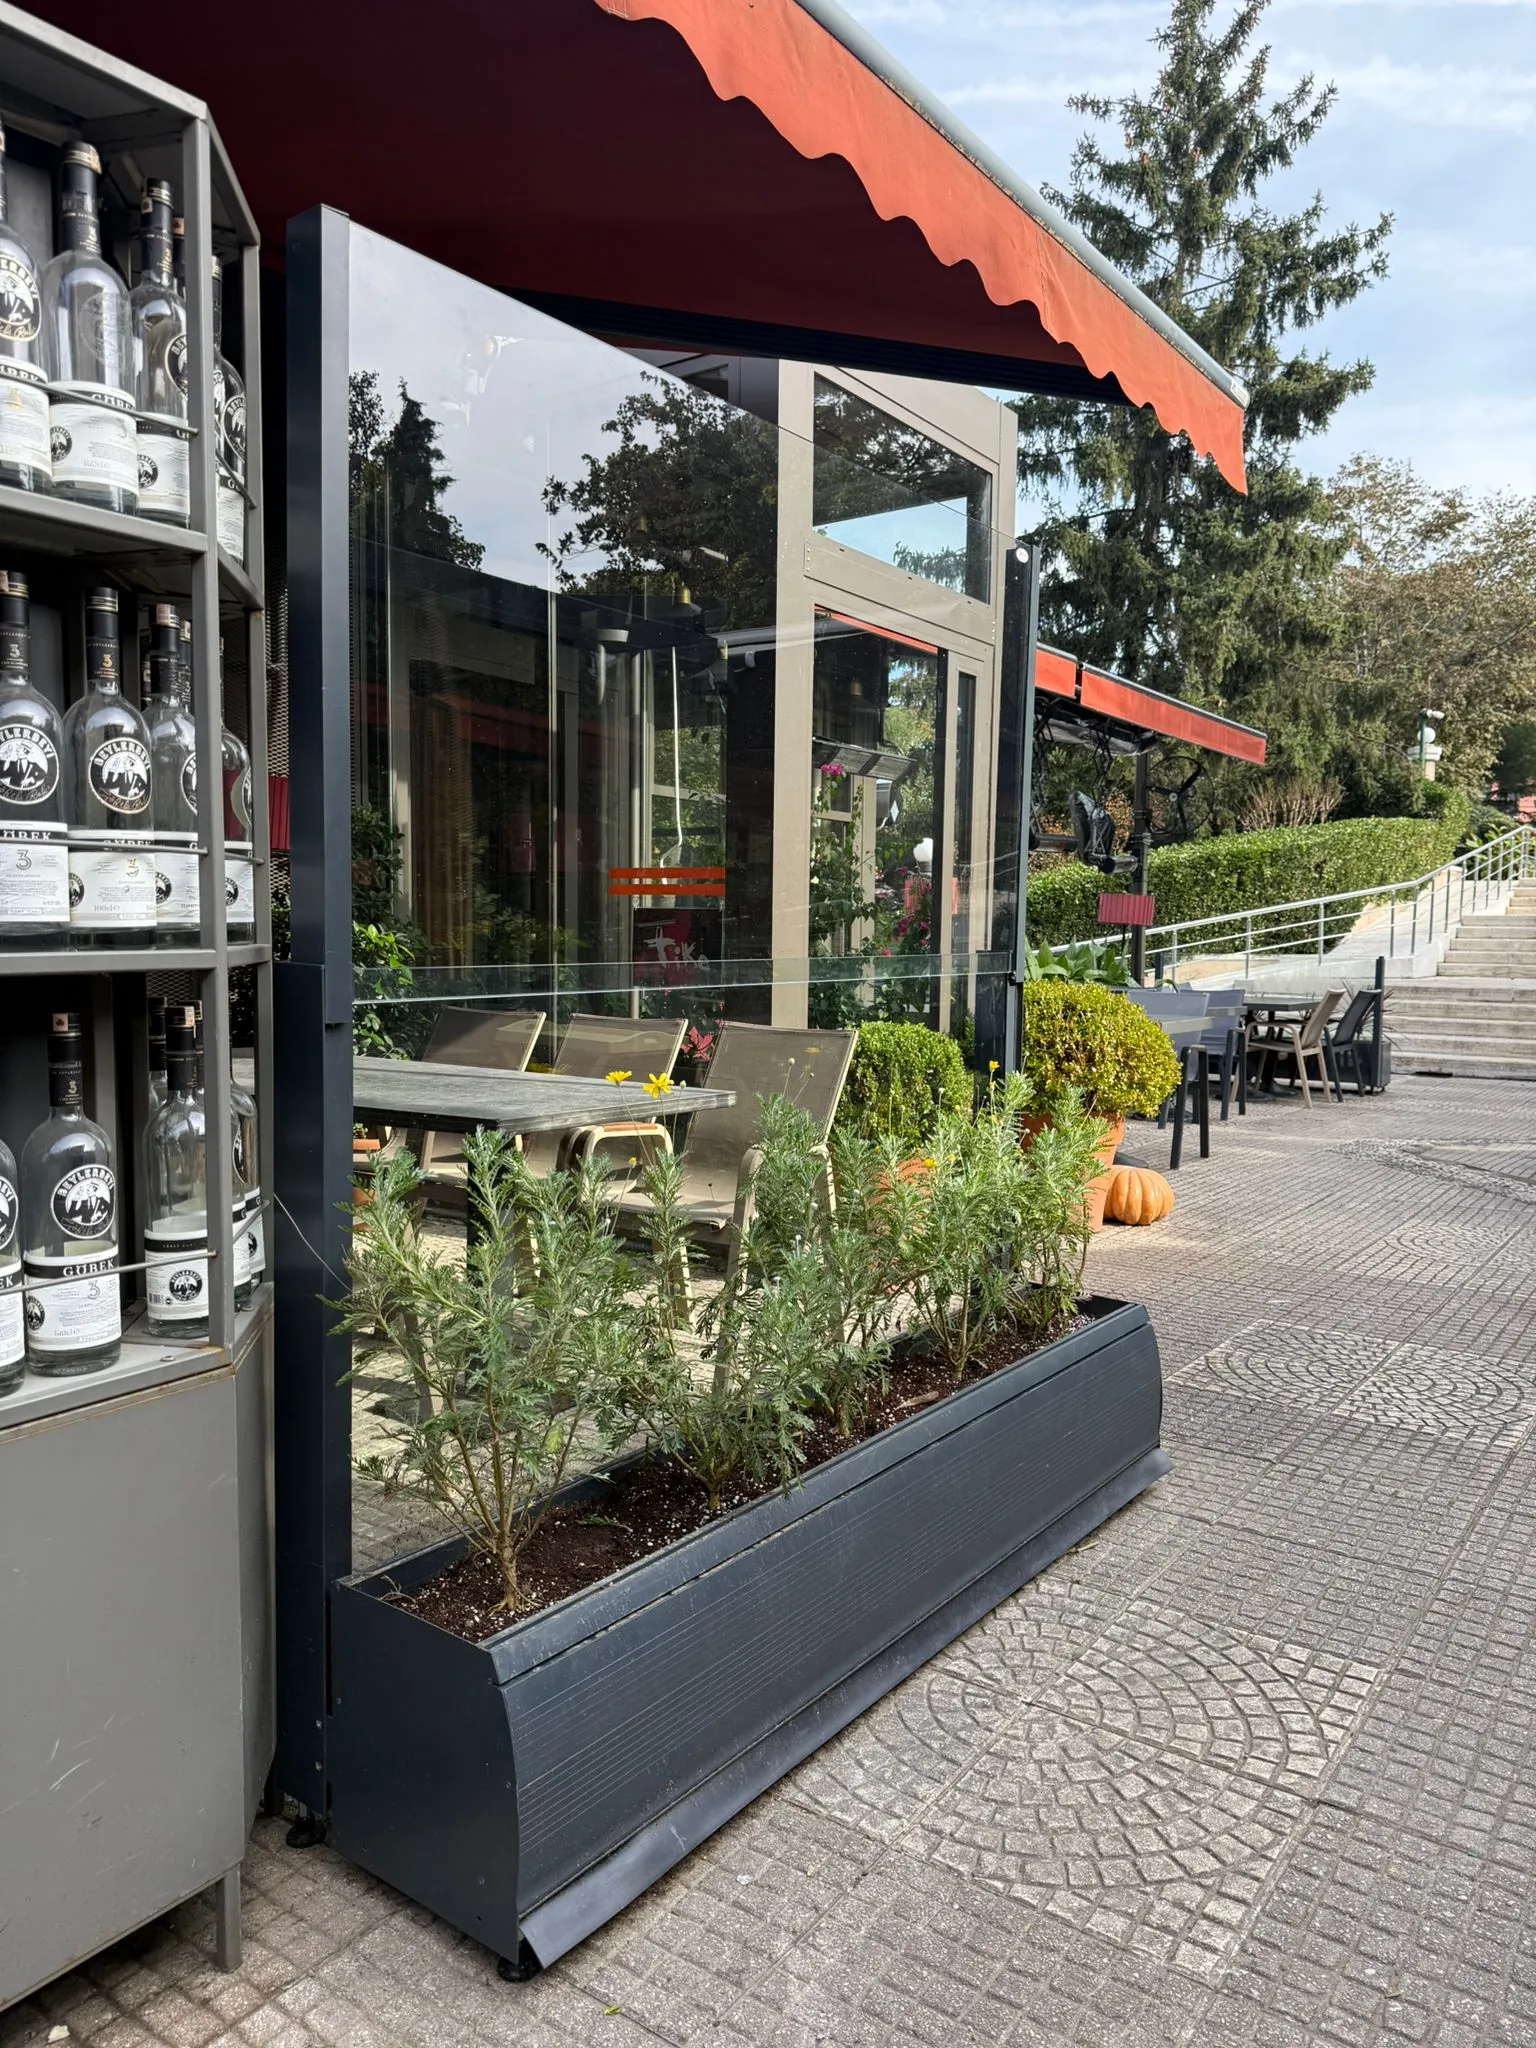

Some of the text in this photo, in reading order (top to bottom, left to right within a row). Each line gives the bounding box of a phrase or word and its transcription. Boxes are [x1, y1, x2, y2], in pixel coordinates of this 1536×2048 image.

[3, 829, 52, 841] ÖBEK
[16, 849, 32, 870] 3
[87, 1280, 101, 1300] 3
